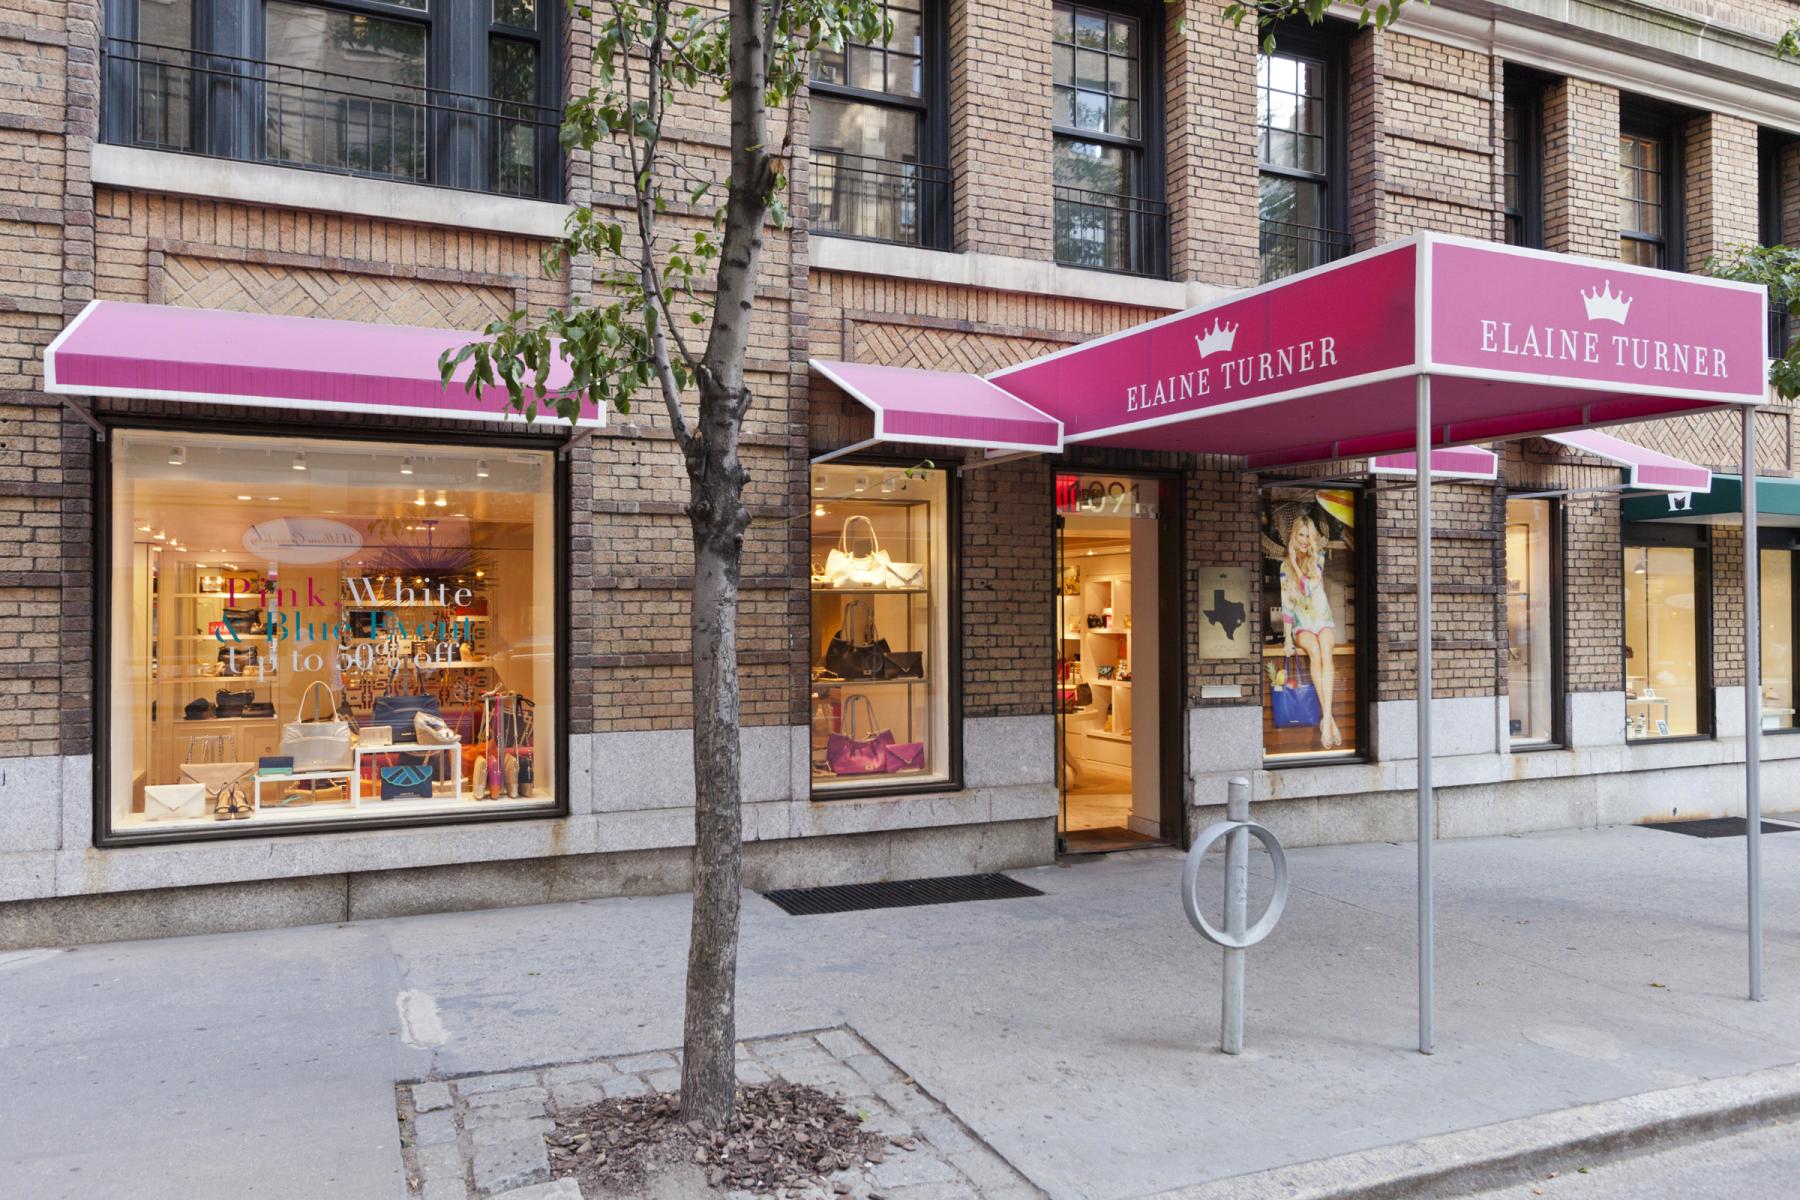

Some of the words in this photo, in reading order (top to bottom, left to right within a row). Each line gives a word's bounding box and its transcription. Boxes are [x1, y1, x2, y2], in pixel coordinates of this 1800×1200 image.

[1480, 319, 1599, 364] ELAINE
[1612, 335, 1728, 378] TURNER
[1126, 367, 1210, 412] ELAINE
[1221, 336, 1338, 390] TURNER
[1068, 480, 1141, 514] 1091
[346, 577, 472, 608] White
[214, 612, 242, 643] &
[266, 611, 353, 641] Blue
[368, 610, 472, 641] Event
[226, 646, 278, 683] Up
[291, 650, 323, 672] to
[336, 643, 402, 672] 50%
[413, 641, 460, 670] off
